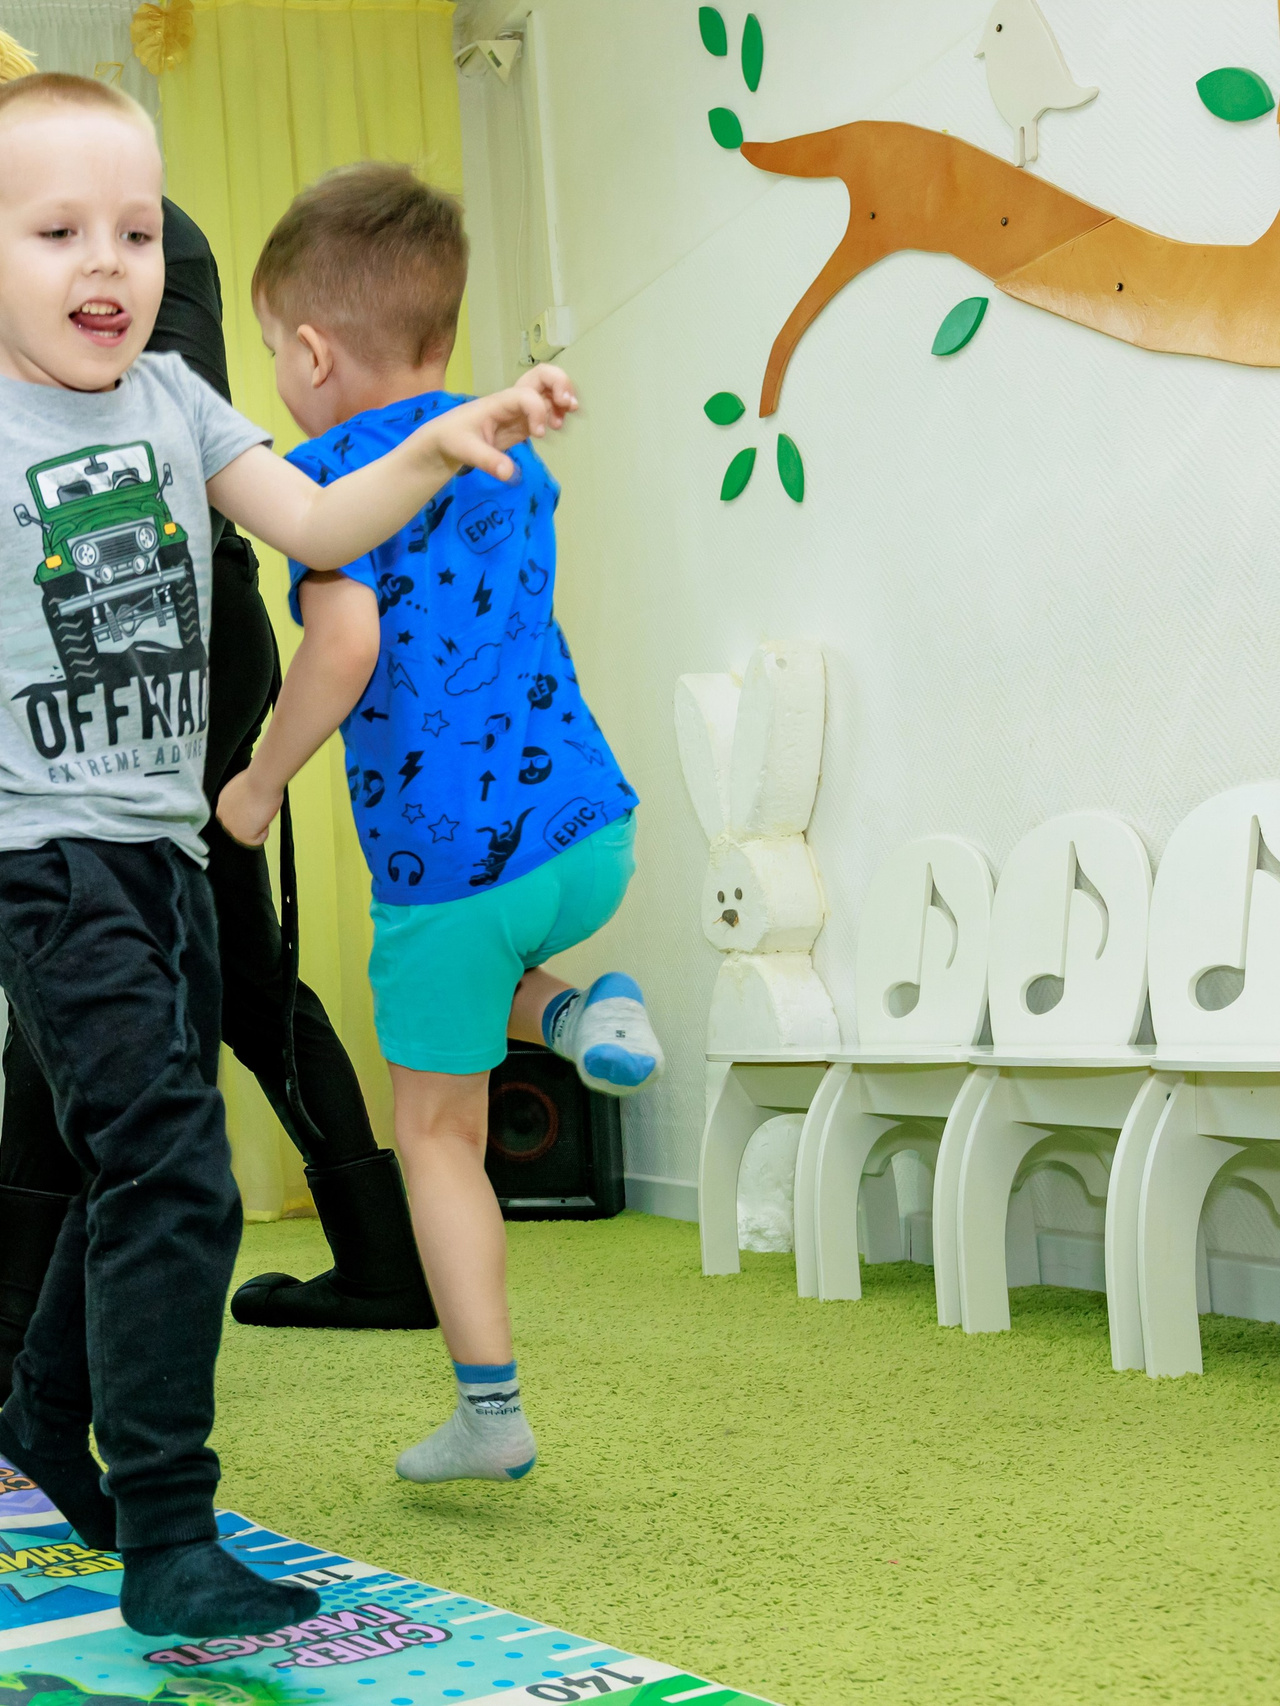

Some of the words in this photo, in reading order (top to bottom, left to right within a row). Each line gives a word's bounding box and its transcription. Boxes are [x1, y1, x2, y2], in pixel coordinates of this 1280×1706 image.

[465, 510, 504, 543] EPIC
[553, 806, 596, 847] EPIC
[270, 1622, 452, 1669] СУПЕР-
[525, 1667, 645, 1702] 140
